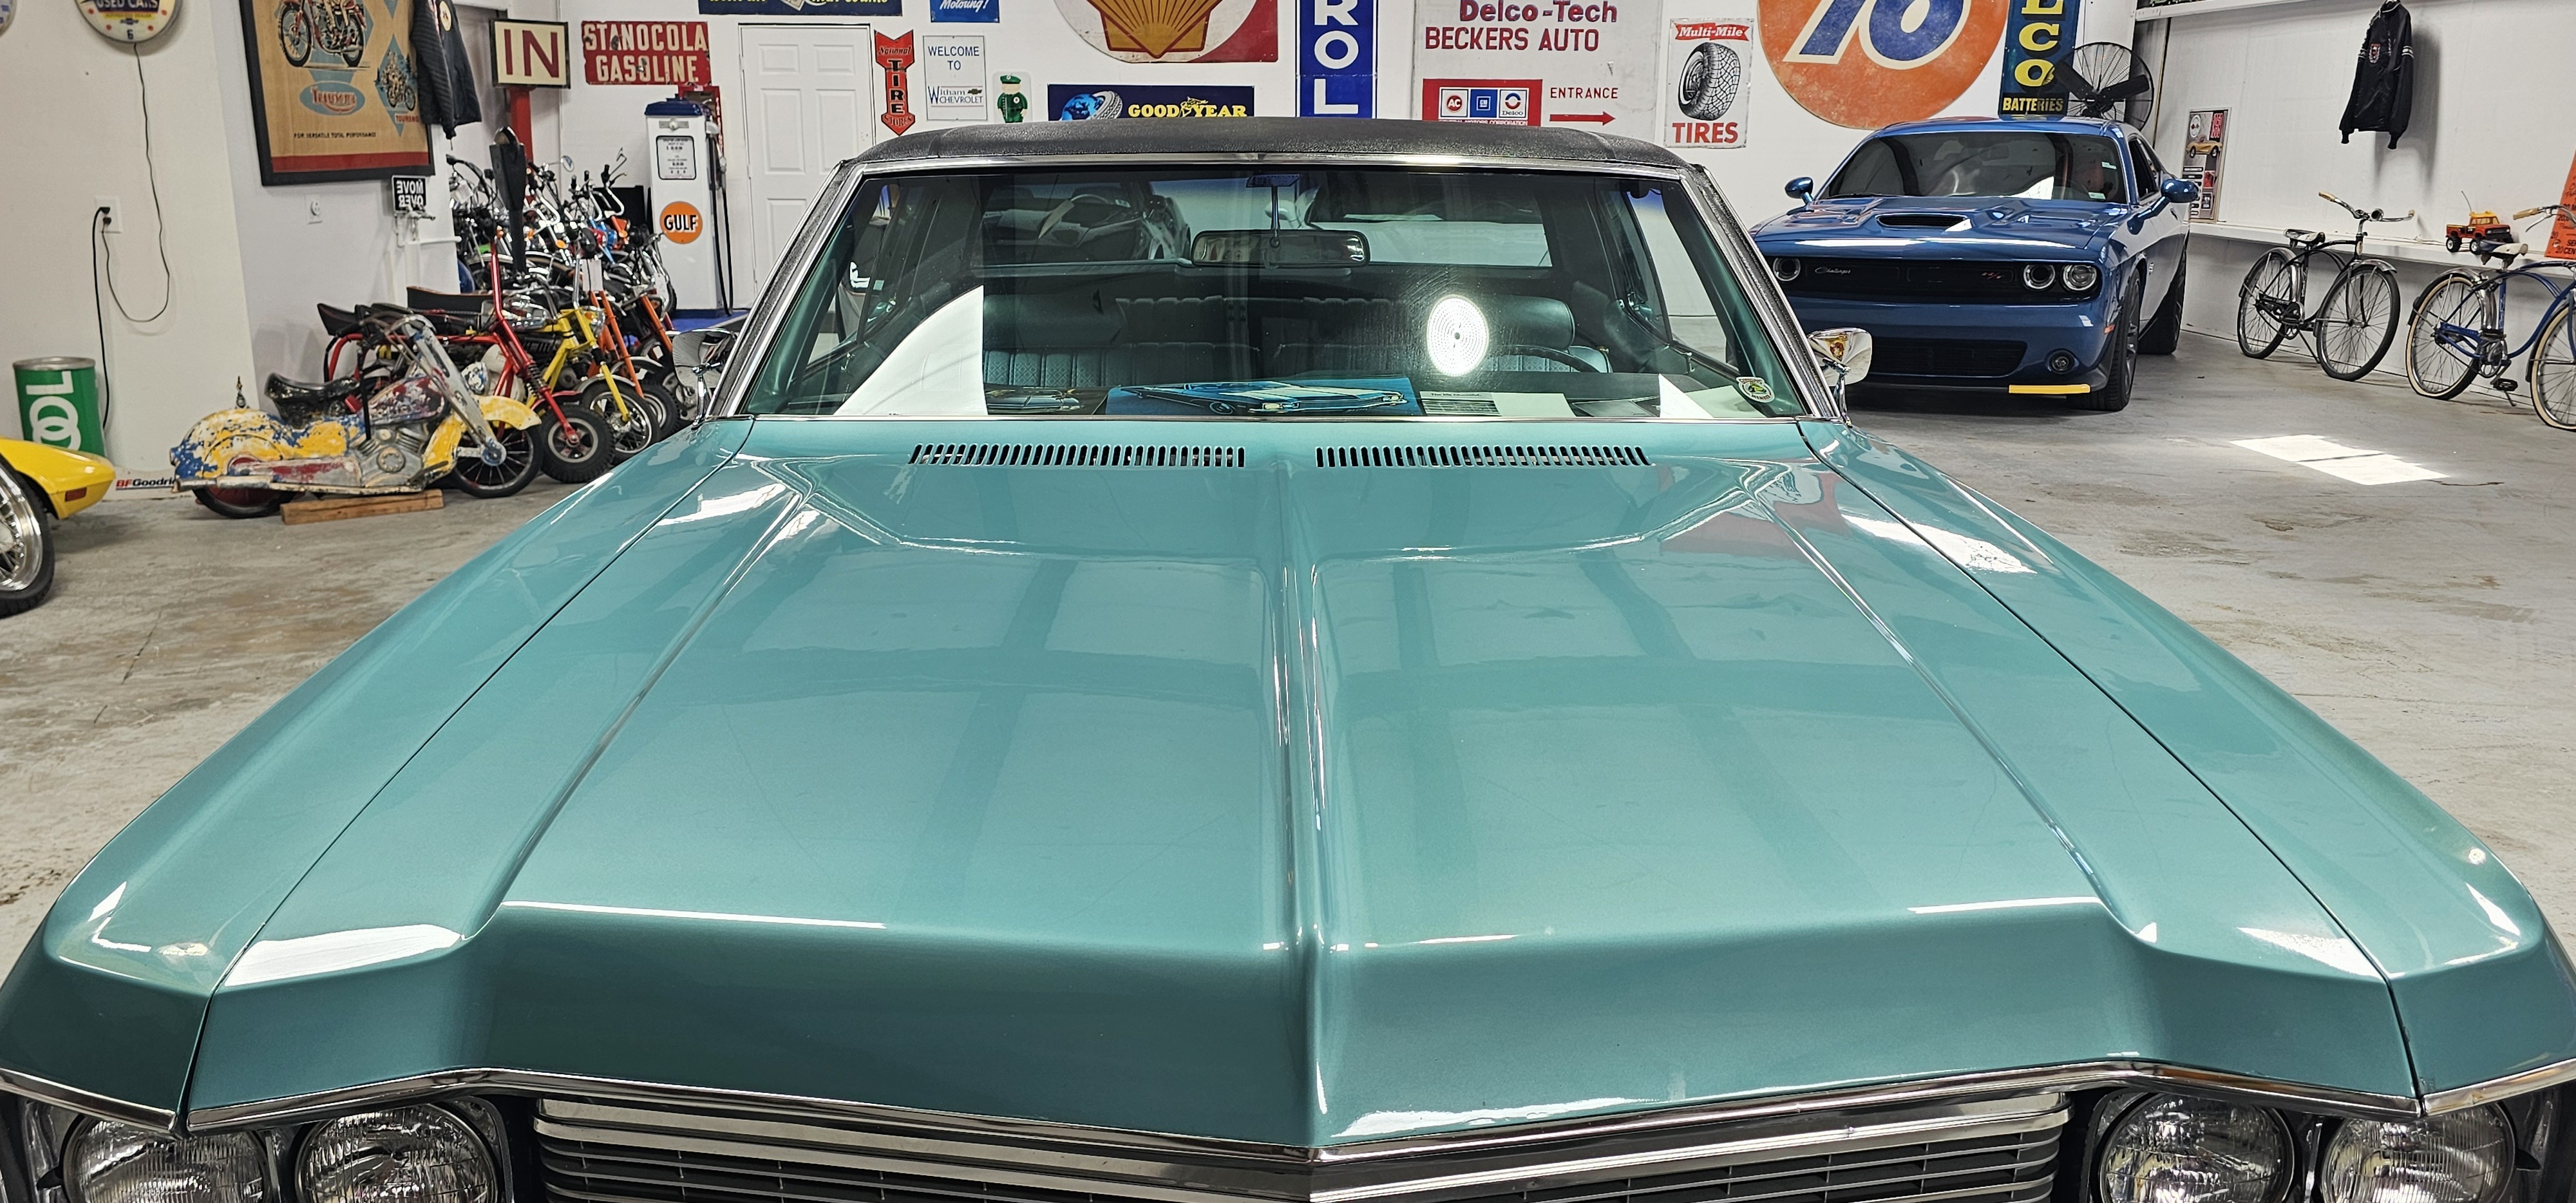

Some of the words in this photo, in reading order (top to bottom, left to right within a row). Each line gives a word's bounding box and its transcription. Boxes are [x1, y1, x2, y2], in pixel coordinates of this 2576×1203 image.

[584, 24, 707, 52] STANOCOLA
[1425, 26, 1529, 50] BECKERS
[1539, 28, 1599, 52] AUTO
[1679, 26, 1743, 37] Multi-Mile
[504, 28, 559, 79] IN
[879, 46, 912, 55] National
[928, 46, 980, 56] WELCOME
[596, 54, 698, 83] GASOLINE
[947, 61, 961, 70] TO
[888, 60, 905, 113] TIRE
[1550, 88, 1618, 99] ENTRANCE
[927, 86, 965, 104] Witham
[1447, 99, 1462, 108] AC
[2002, 97, 2063, 111] BATTERIES
[884, 115, 913, 127] STORES
[1672, 122, 1739, 143] TIRES
[664, 214, 697, 231] GULF
